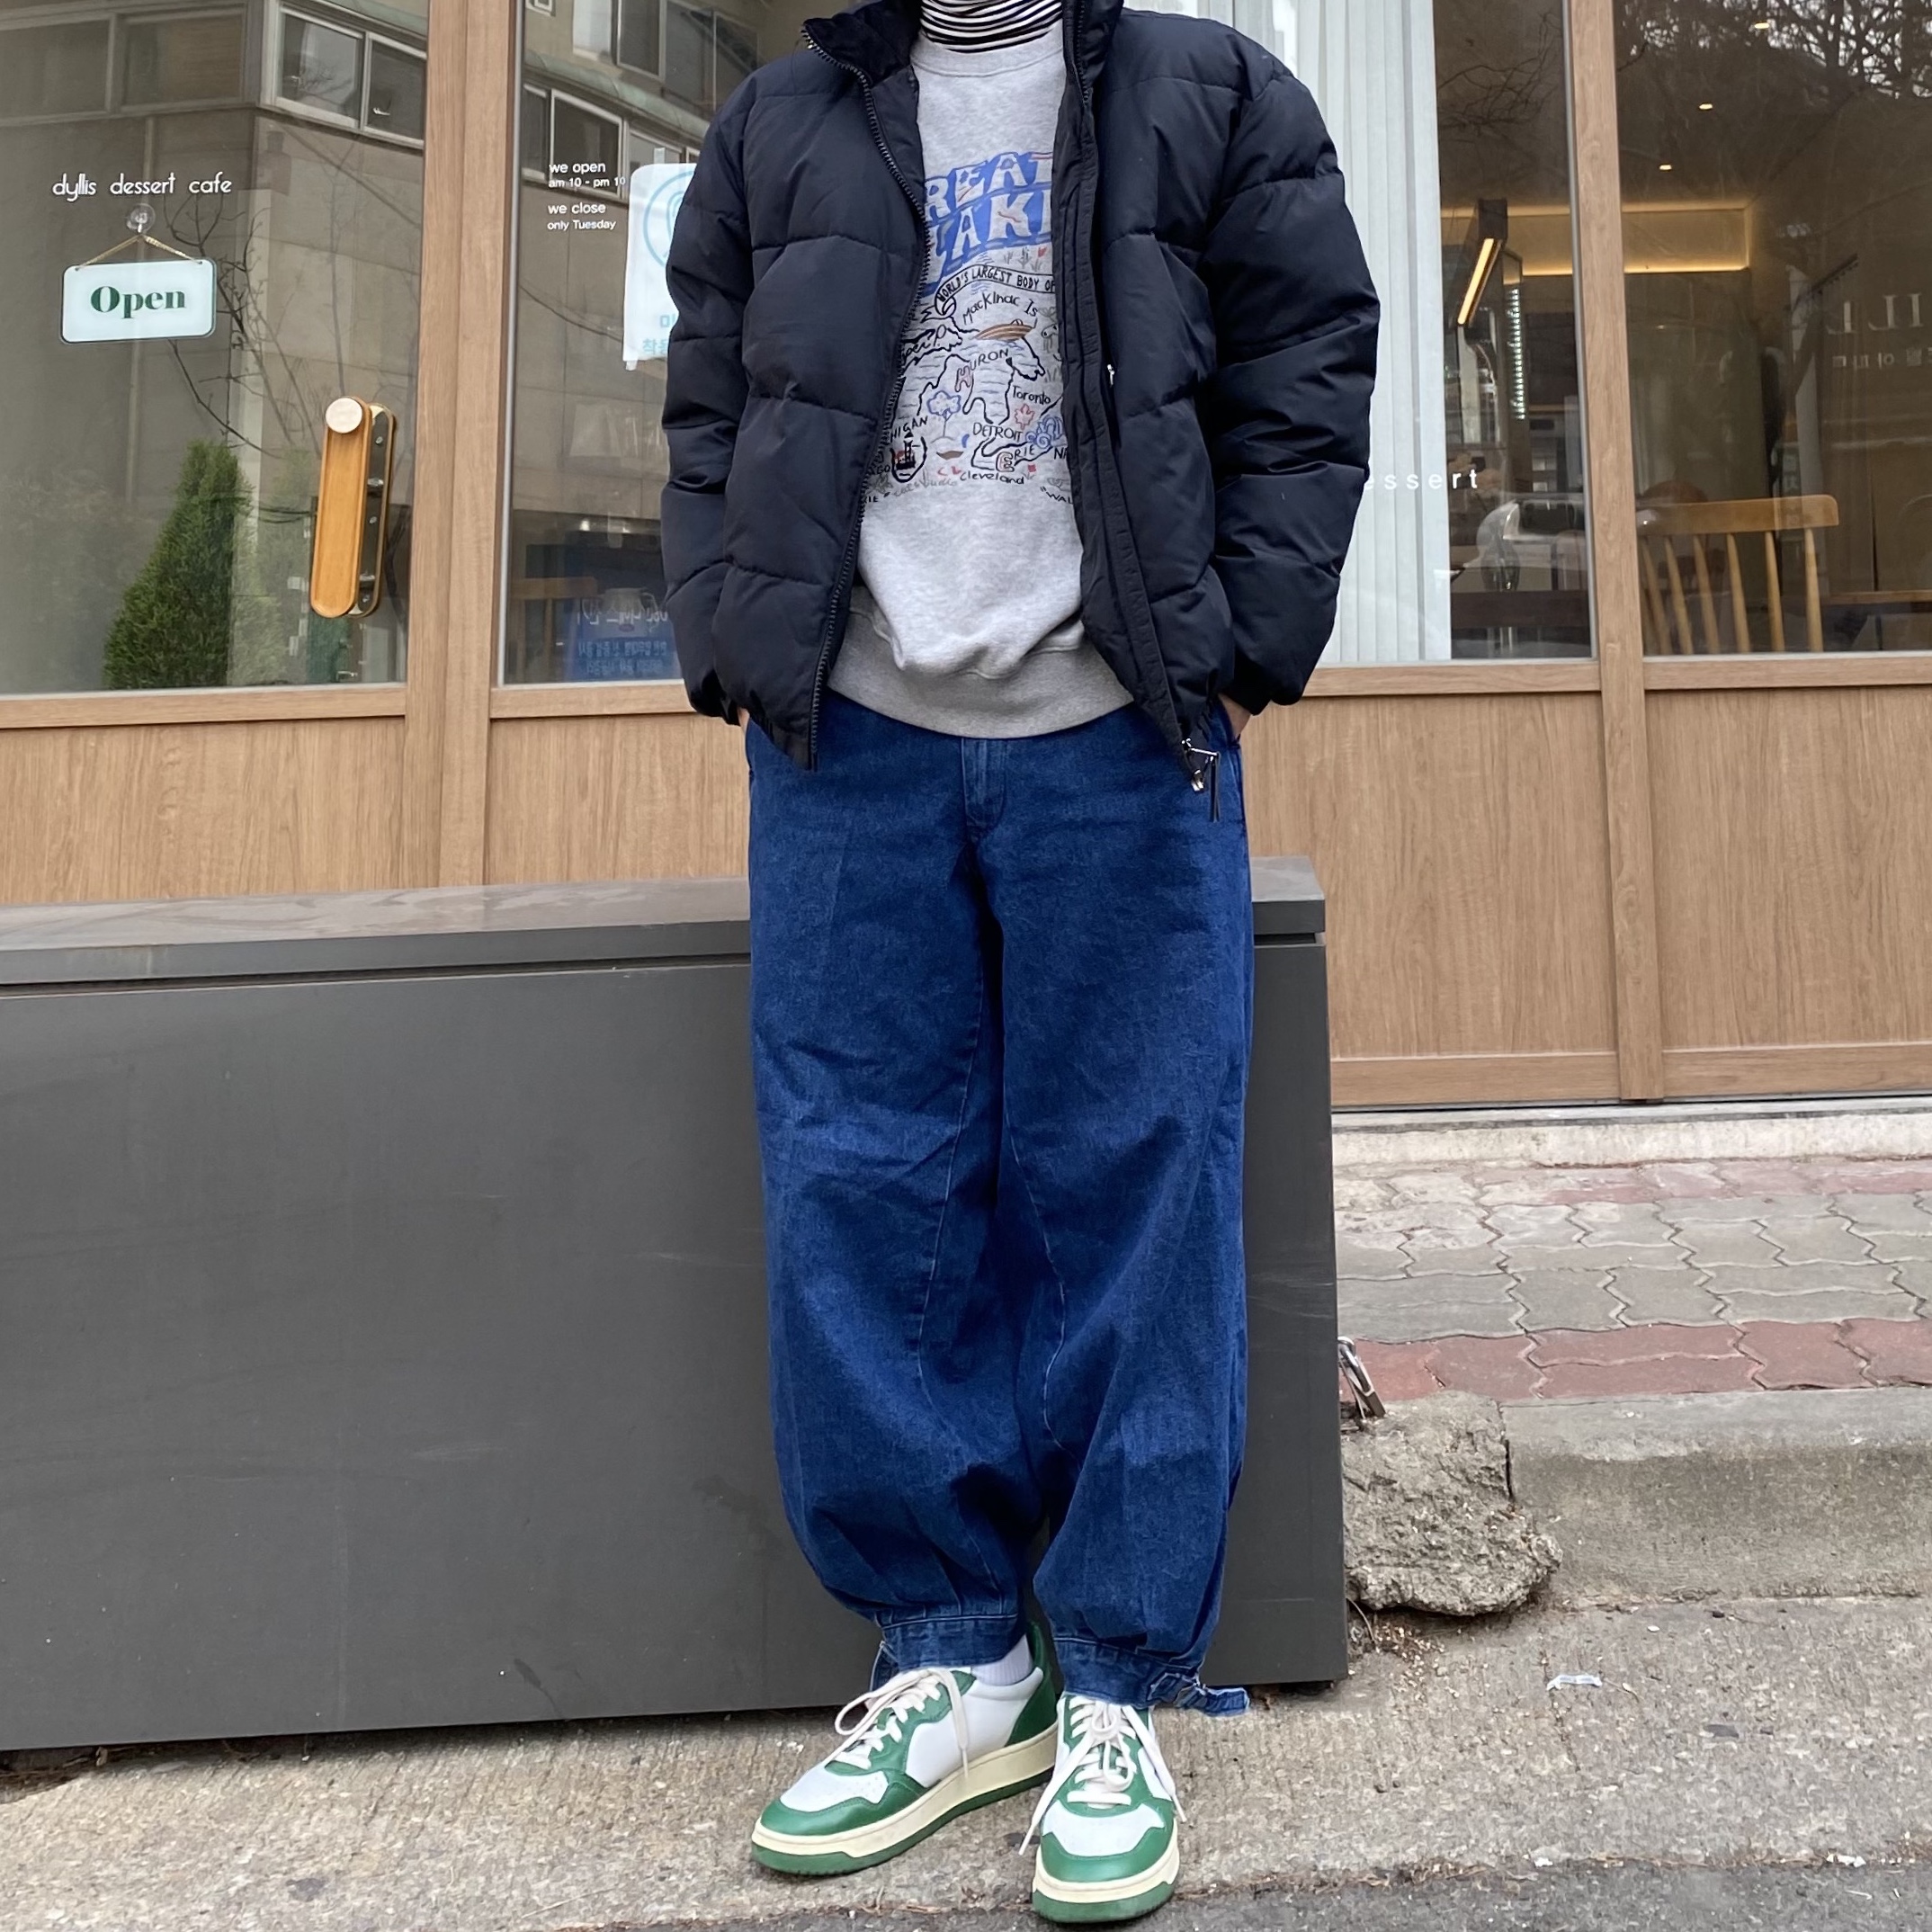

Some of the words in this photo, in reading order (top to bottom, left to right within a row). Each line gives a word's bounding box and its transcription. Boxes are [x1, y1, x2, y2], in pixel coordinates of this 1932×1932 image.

[549, 164, 568, 174] we
[572, 163, 606, 174] open
[110, 172, 175, 195] dessert
[188, 171, 232, 193] cafe
[548, 179, 565, 188] am
[568, 177, 582, 187] 10
[593, 179, 610, 189] pm
[613, 176, 626, 186] 10
[548, 204, 568, 214] we
[571, 201, 606, 214] close
[547, 220, 569, 231] only
[572, 219, 616, 230] Tuesday
[971, 266, 1012, 283] LARGEST
[1016, 274, 1040, 289] BODY
[90, 285, 187, 319] Open
[1012, 385, 1051, 405] Toronto
[973, 422, 1024, 442] DETROIT
[960, 470, 1024, 485] Cleveland
[1364, 469, 1478, 489] essert
